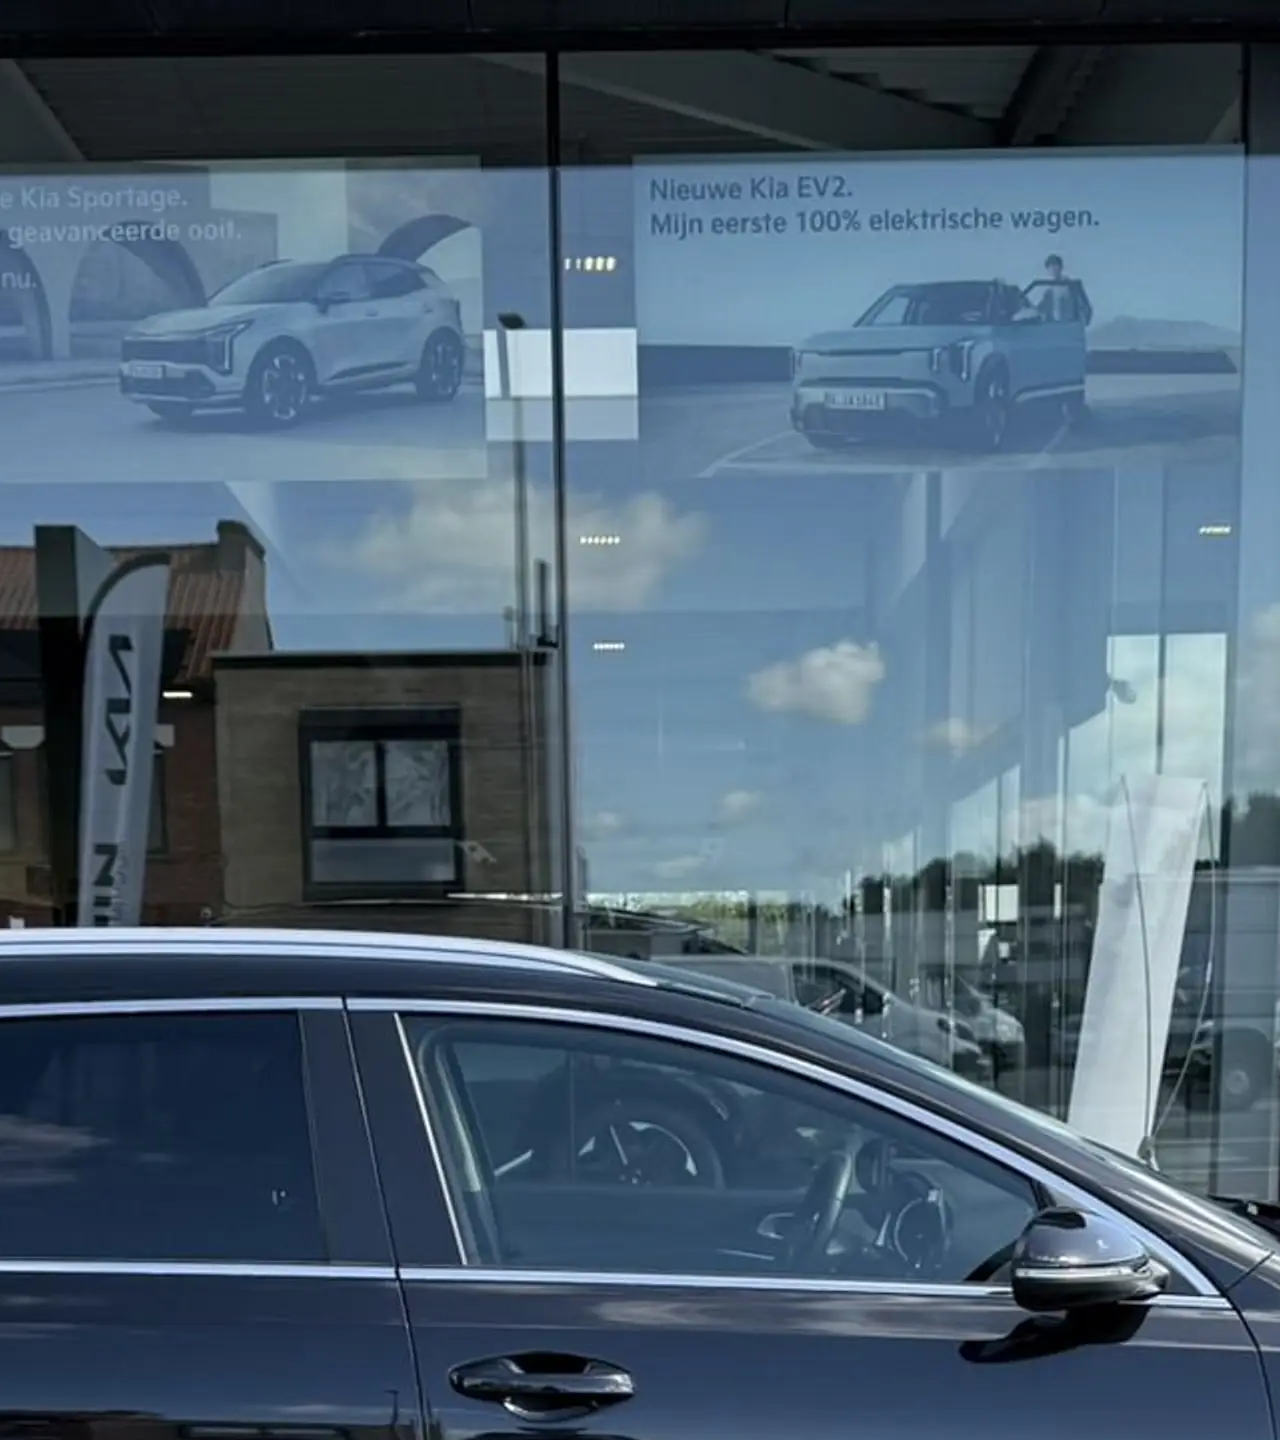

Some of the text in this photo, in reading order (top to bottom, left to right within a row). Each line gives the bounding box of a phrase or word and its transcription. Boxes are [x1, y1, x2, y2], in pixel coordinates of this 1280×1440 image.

[21, 186, 60, 209] Kia
[67, 185, 188, 213] Sportage.
[650, 175, 854, 201] Nieuwe Kia EV2.
[8, 218, 180, 250] geavanceerde
[188, 218, 242, 241] ooit.
[650, 207, 1100, 240] Mijn eerste 100% elektrische wagen.
[1, 270, 38, 290] nu.
